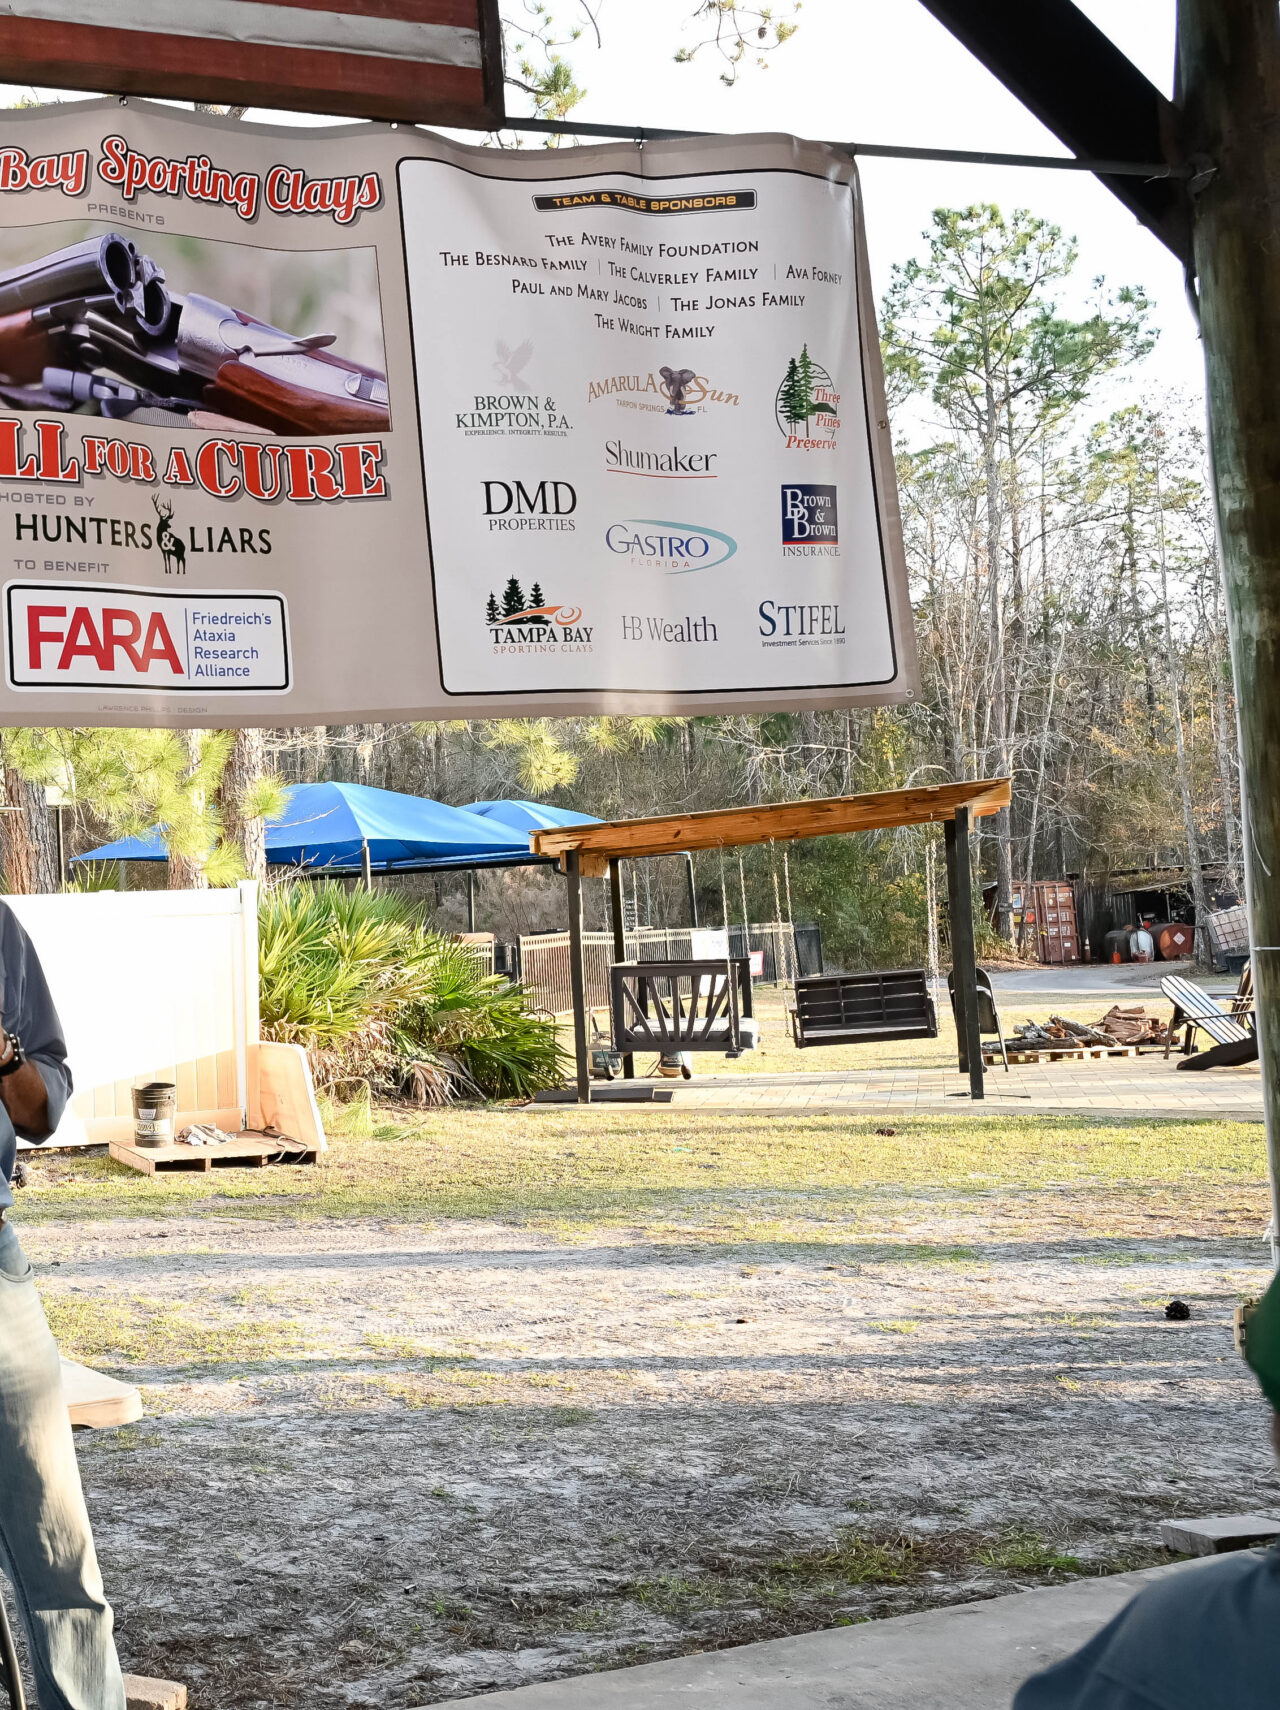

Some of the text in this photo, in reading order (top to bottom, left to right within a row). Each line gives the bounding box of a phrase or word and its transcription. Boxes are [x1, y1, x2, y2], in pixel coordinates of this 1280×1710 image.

[97, 135, 260, 220] Sporting
[265, 164, 382, 225] Clays
[553, 193, 737, 211] TEAM & TABLE SPONSORS
[88, 203, 165, 225] PRESENTS
[545, 232, 759, 258] THE AVERY FAMILY FOUNDATION
[439, 251, 843, 286] THE BESNARD FAMILY THE CALVERLEY FAMILY AVA FORNEY
[512, 279, 805, 312] PAUL AND MARY JACOBS THE JONAS FAMILY
[594, 313, 715, 339] THE WRIGHT FAMILY
[588, 373, 658, 403] AMARULA
[815, 388, 840, 403] Three
[474, 395, 557, 411] BROWN &
[455, 412, 574, 430] KIMPTON, P.A.
[815, 413, 840, 429] Pines
[785, 435, 837, 450] Preserve
[605, 440, 717, 472] Shumaker
[81, 435, 156, 482] FOR
[163, 446, 194, 484] A
[195, 438, 387, 500] CURE
[74, 496, 95, 507] BY
[480, 480, 577, 515] DMD
[783, 489, 831, 519] Brown
[489, 518, 576, 531] PROPERTIES
[792, 508, 837, 538] Brown
[815, 509, 825, 523] &
[15, 513, 272, 554] HUNTERS & LIARS
[606, 524, 709, 558] GASTRO
[783, 546, 841, 557] INSURANCE
[14, 559, 110, 574] TO BENEFIT
[630, 558, 691, 568] FLORIDA
[192, 611, 272, 625] Friedreich's
[759, 600, 845, 637] STIFEL
[193, 629, 236, 642] Ataxia
[490, 627, 593, 644] TAMPA BAY
[621, 616, 718, 643] HB Wealth
[27, 605, 184, 674] FARA
[762, 640, 797, 648] Investment
[798, 638, 819, 646] Services
[194, 646, 259, 660] Research
[493, 644, 593, 654] SPORTING CLAYS
[195, 664, 250, 677] Alliance
